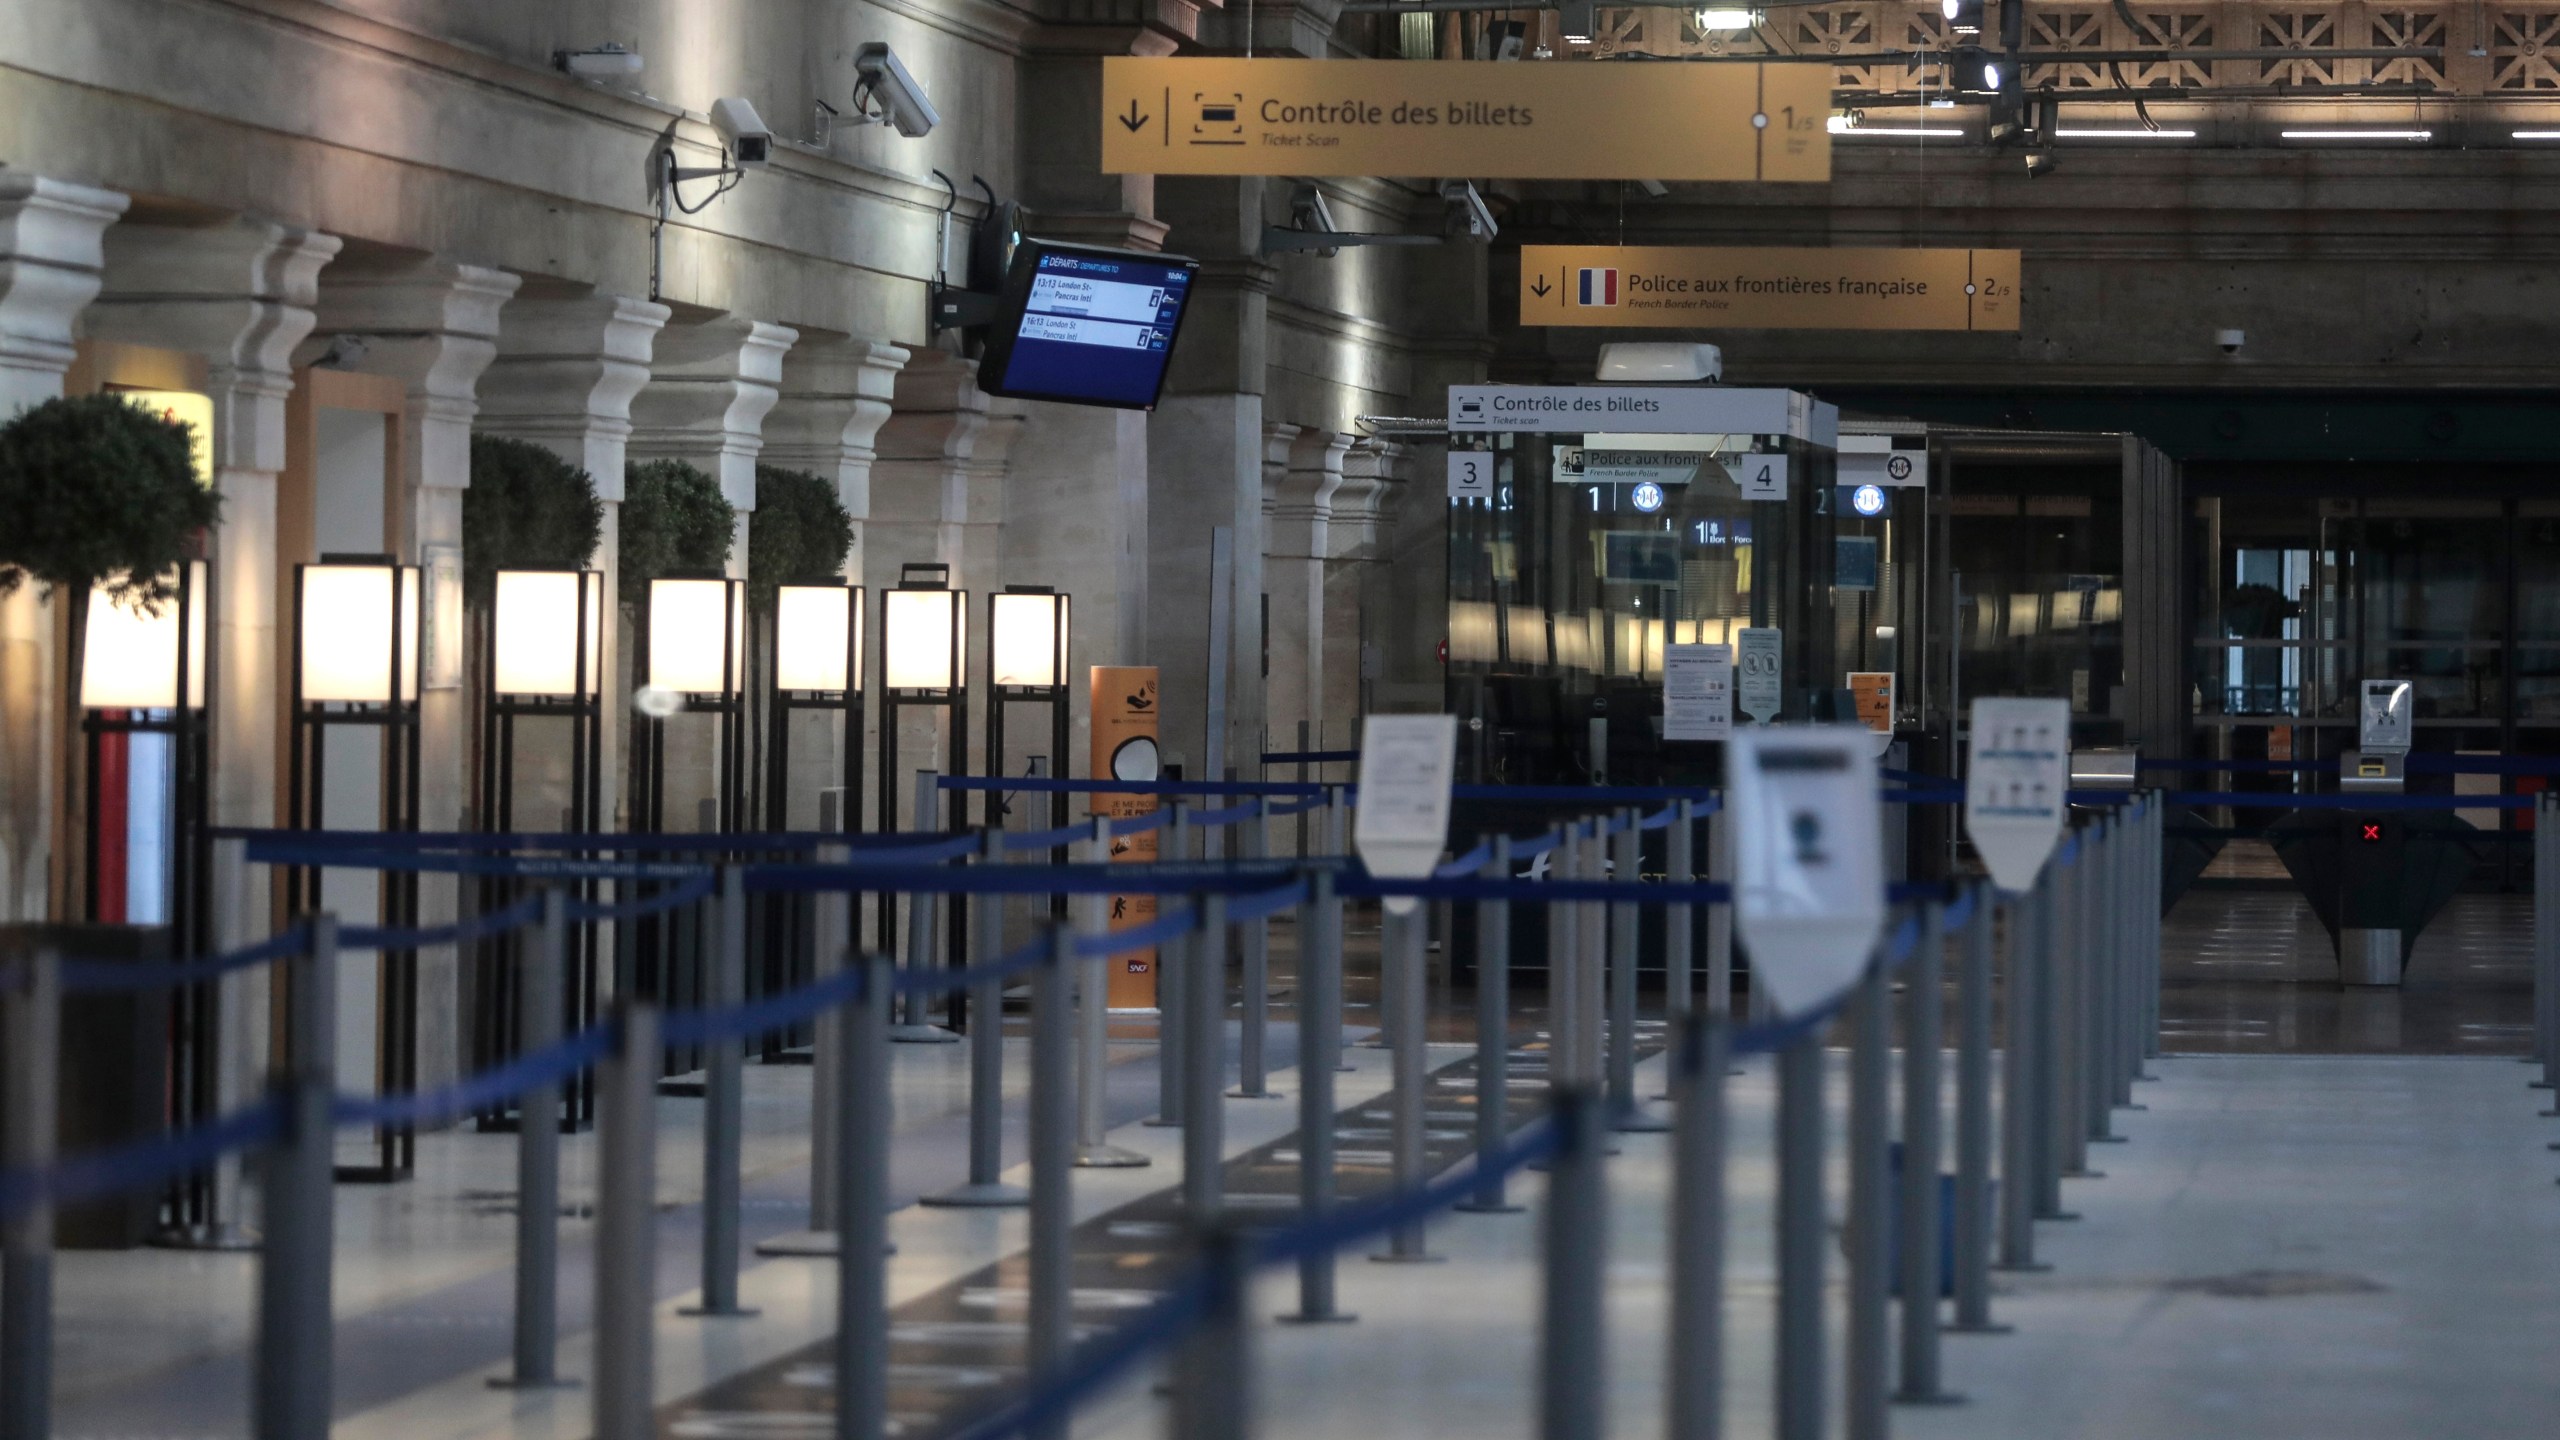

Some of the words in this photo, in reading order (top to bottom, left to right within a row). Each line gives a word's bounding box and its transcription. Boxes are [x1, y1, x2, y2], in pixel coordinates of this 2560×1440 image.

[1261, 99, 1381, 126] Contrôle
[1391, 101, 1438, 126] des
[1447, 100, 1534, 127] billets
[1261, 132, 1301, 147] Ticket
[1306, 133, 1340, 147] Scan
[1049, 256, 1079, 269] DÉPARTS
[1037, 278, 1056, 289] 13:13
[1058, 279, 1081, 289] London
[1628, 274, 1688, 293] Police
[1694, 279, 1729, 293] aux
[1735, 275, 1832, 294] frontières
[1838, 277, 1928, 299] française
[1055, 291, 1079, 301] Pancras
[1628, 298, 1663, 309] French
[1665, 298, 1698, 310] Border
[1700, 299, 1729, 310] Police
[1026, 316, 1044, 327] 16:13
[1046, 319, 1069, 329] London
[1043, 330, 1066, 340] Pancras
[1493, 395, 1568, 411] Contrôle
[1573, 397, 1602, 411] des
[1607, 397, 1660, 412] billets
[1493, 416, 1518, 425] Ticket
[1520, 417, 1540, 425] scan
[1590, 452, 1632, 466] Police
[1634, 455, 1660, 466] aux
[1462, 461, 1477, 484] 3
[1590, 469, 1613, 477] French
[1614, 469, 1637, 477] Border
[1639, 470, 1659, 478] Police
[1756, 464, 1772, 487] 4
[1588, 486, 1600, 512] 1
[1111, 800, 1120, 808] JE
[1122, 800, 1134, 808] ME
[1129, 964, 1148, 972] SNCF
